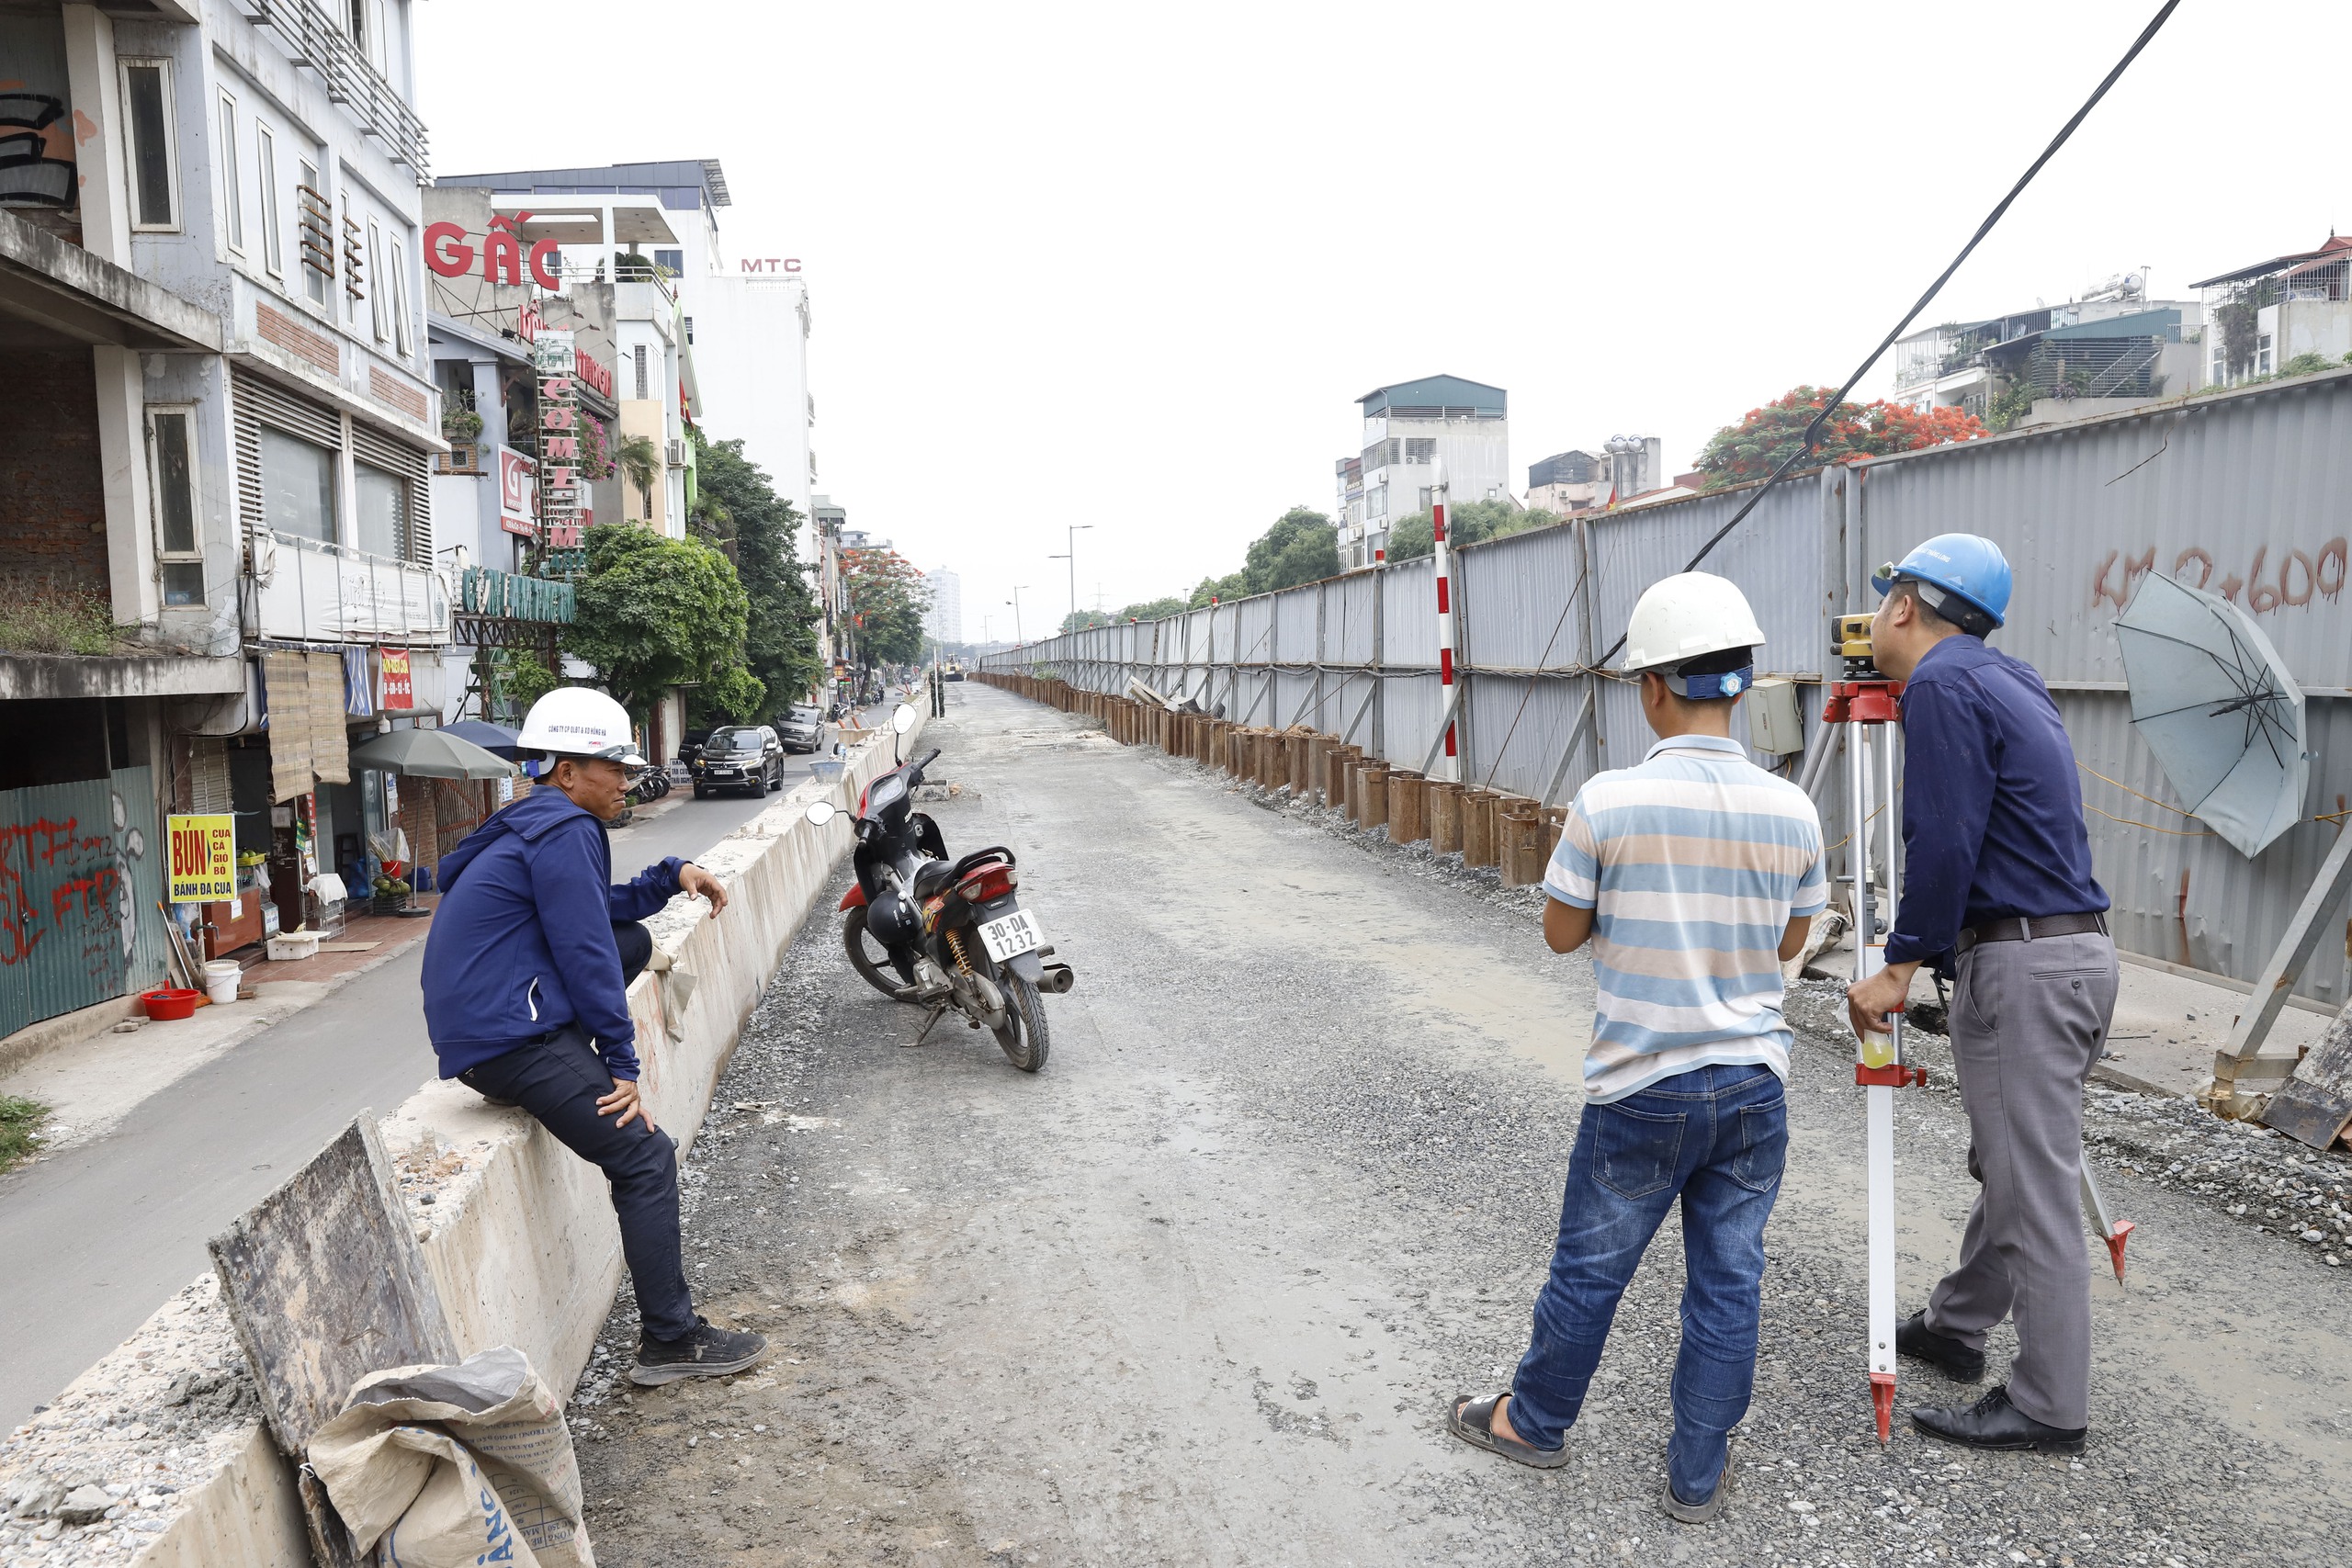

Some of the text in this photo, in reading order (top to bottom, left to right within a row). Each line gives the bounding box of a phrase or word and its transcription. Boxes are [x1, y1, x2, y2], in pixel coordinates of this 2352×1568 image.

[424, 210, 560, 291] GẤC
[741, 258, 801, 273] MTC
[212, 829, 231, 838] CUA
[172, 819, 207, 876] BÚN
[212, 840, 225, 851] CÁ
[213, 852, 229, 863] GIÒ
[213, 864, 226, 874] BÒ
[174, 881, 232, 897] BÁNH ĐA CUA
[988, 915, 1029, 941] 30-DA
[996, 931, 1036, 956] 1232
